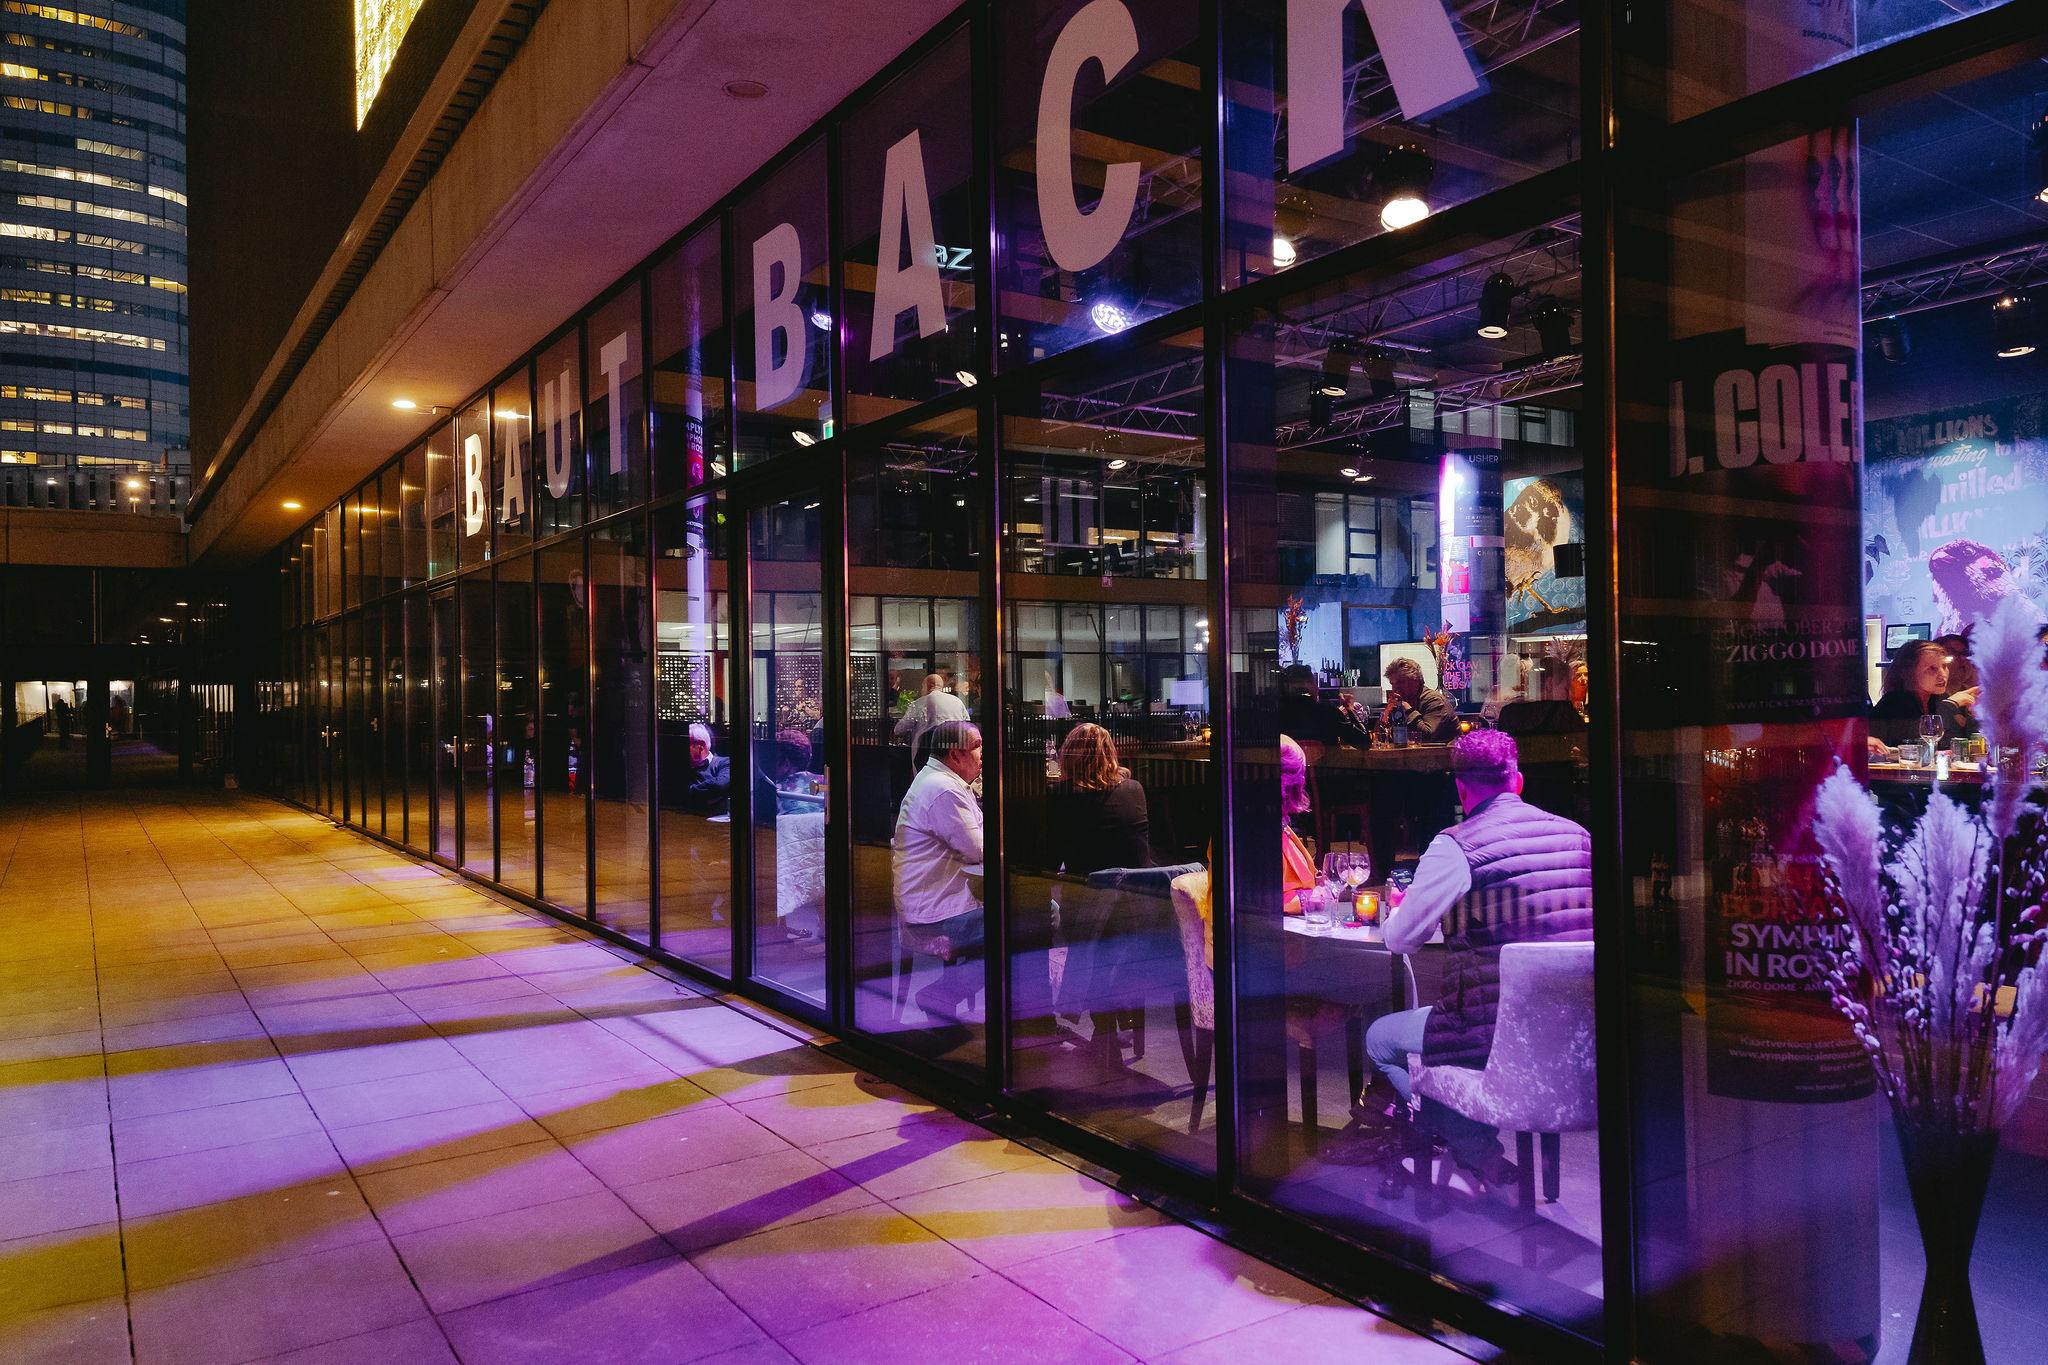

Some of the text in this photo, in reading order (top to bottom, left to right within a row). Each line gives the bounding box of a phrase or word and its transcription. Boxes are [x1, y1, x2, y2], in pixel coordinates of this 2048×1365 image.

[1713, 363, 1852, 470] COLE
[465, 332, 628, 537] BAUT
[1468, 454, 1499, 463] USHER
[1927, 443, 1989, 469] waiting
[1725, 638, 1859, 662] ZIGGO DOME
[1725, 951, 1760, 977] IN
